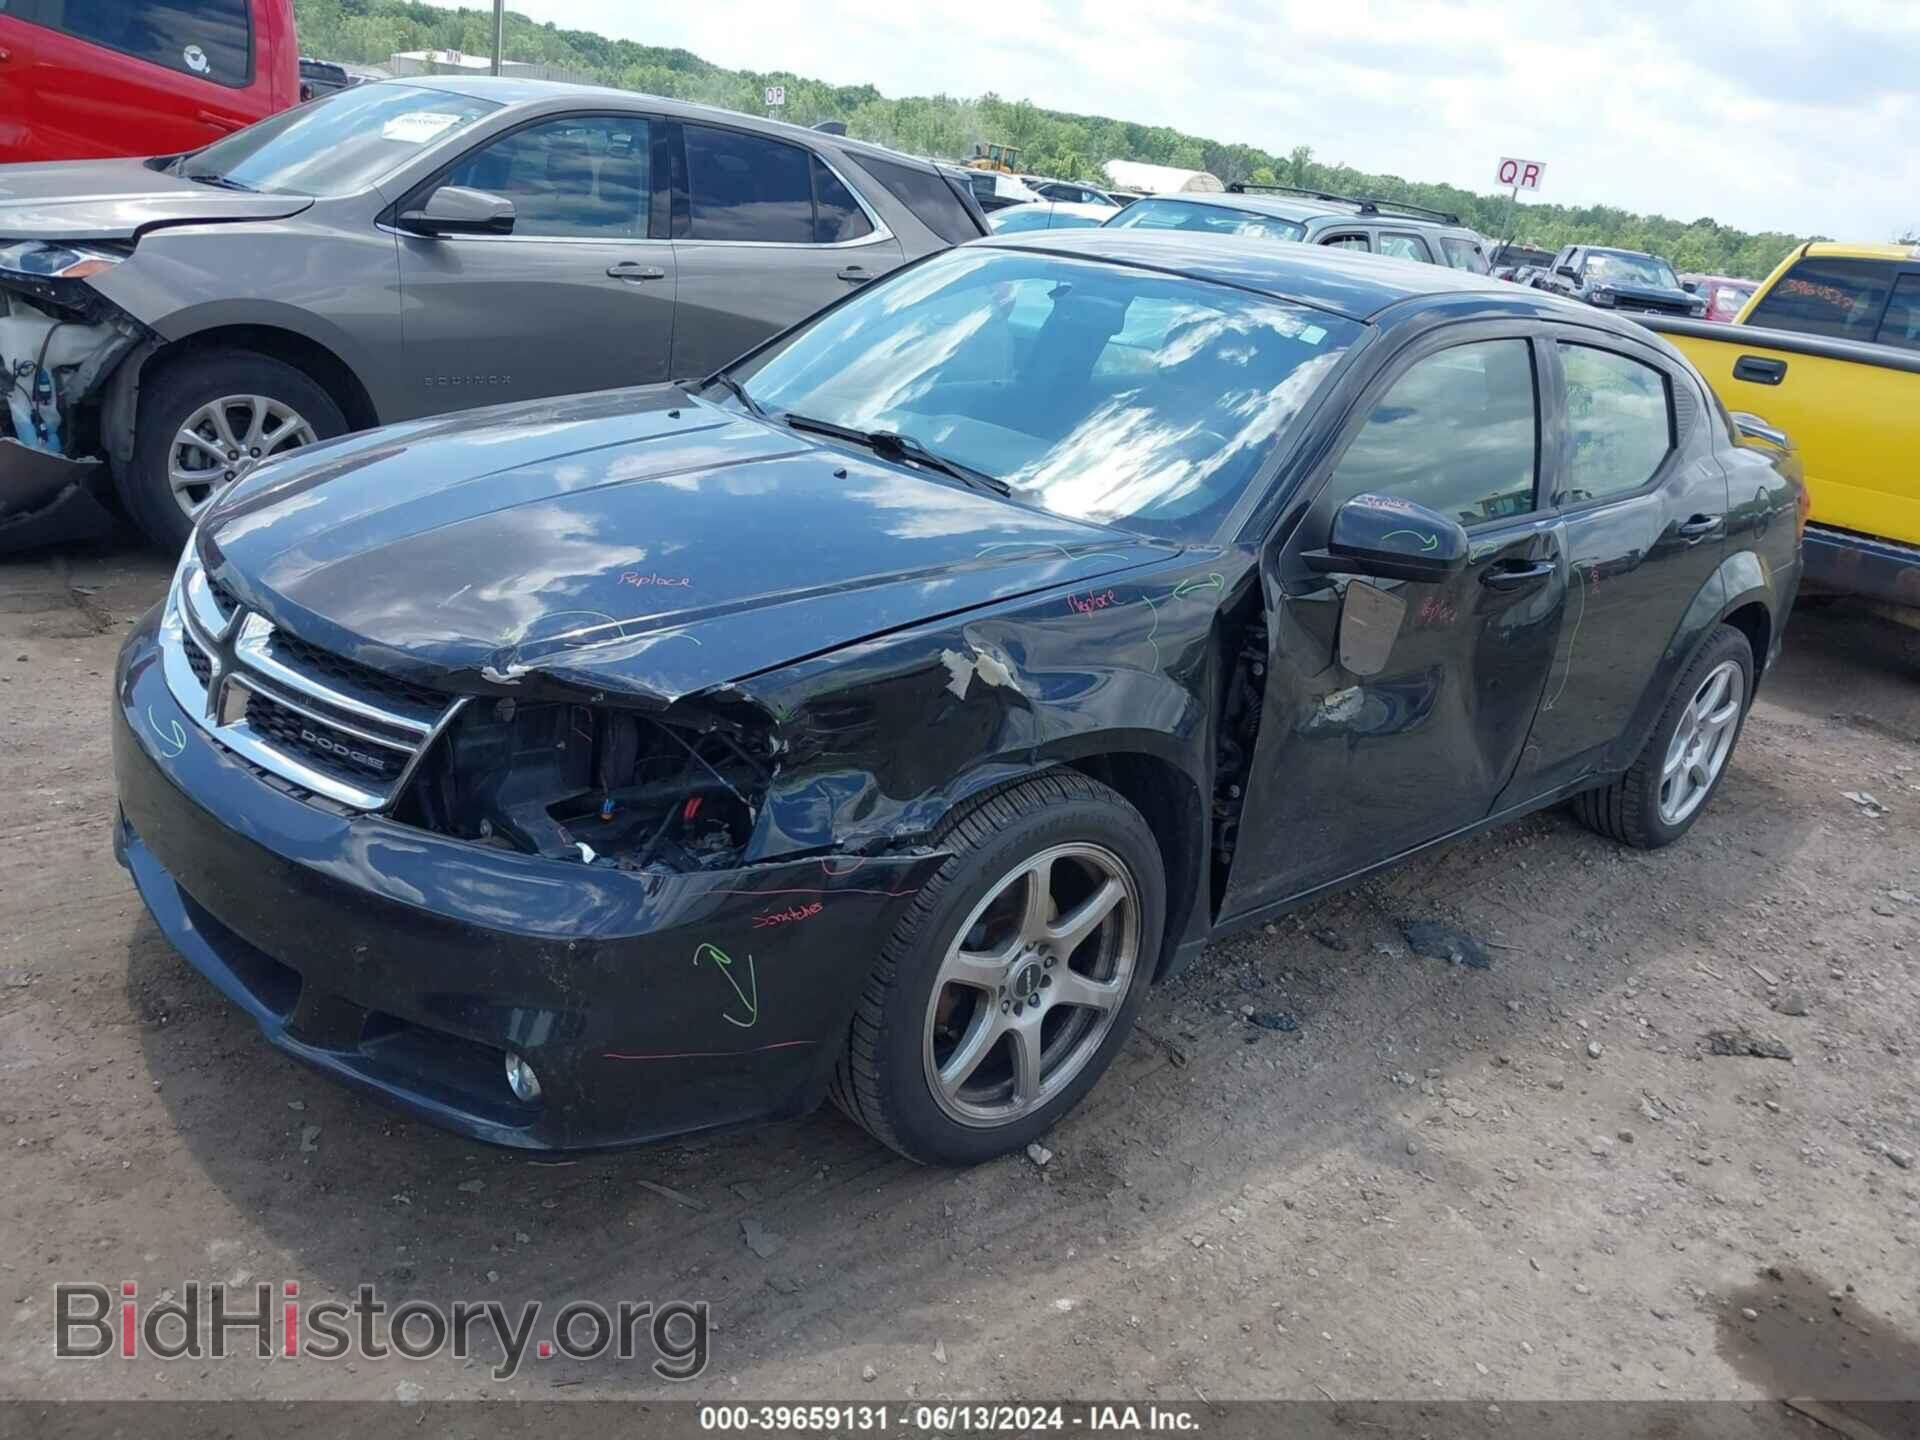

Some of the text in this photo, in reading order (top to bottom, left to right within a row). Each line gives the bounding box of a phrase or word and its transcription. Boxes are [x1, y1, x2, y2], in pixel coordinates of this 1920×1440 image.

[1500, 160, 1540, 188] QR
[617, 570, 692, 588] Replace
[302, 729, 384, 770] DODGE
